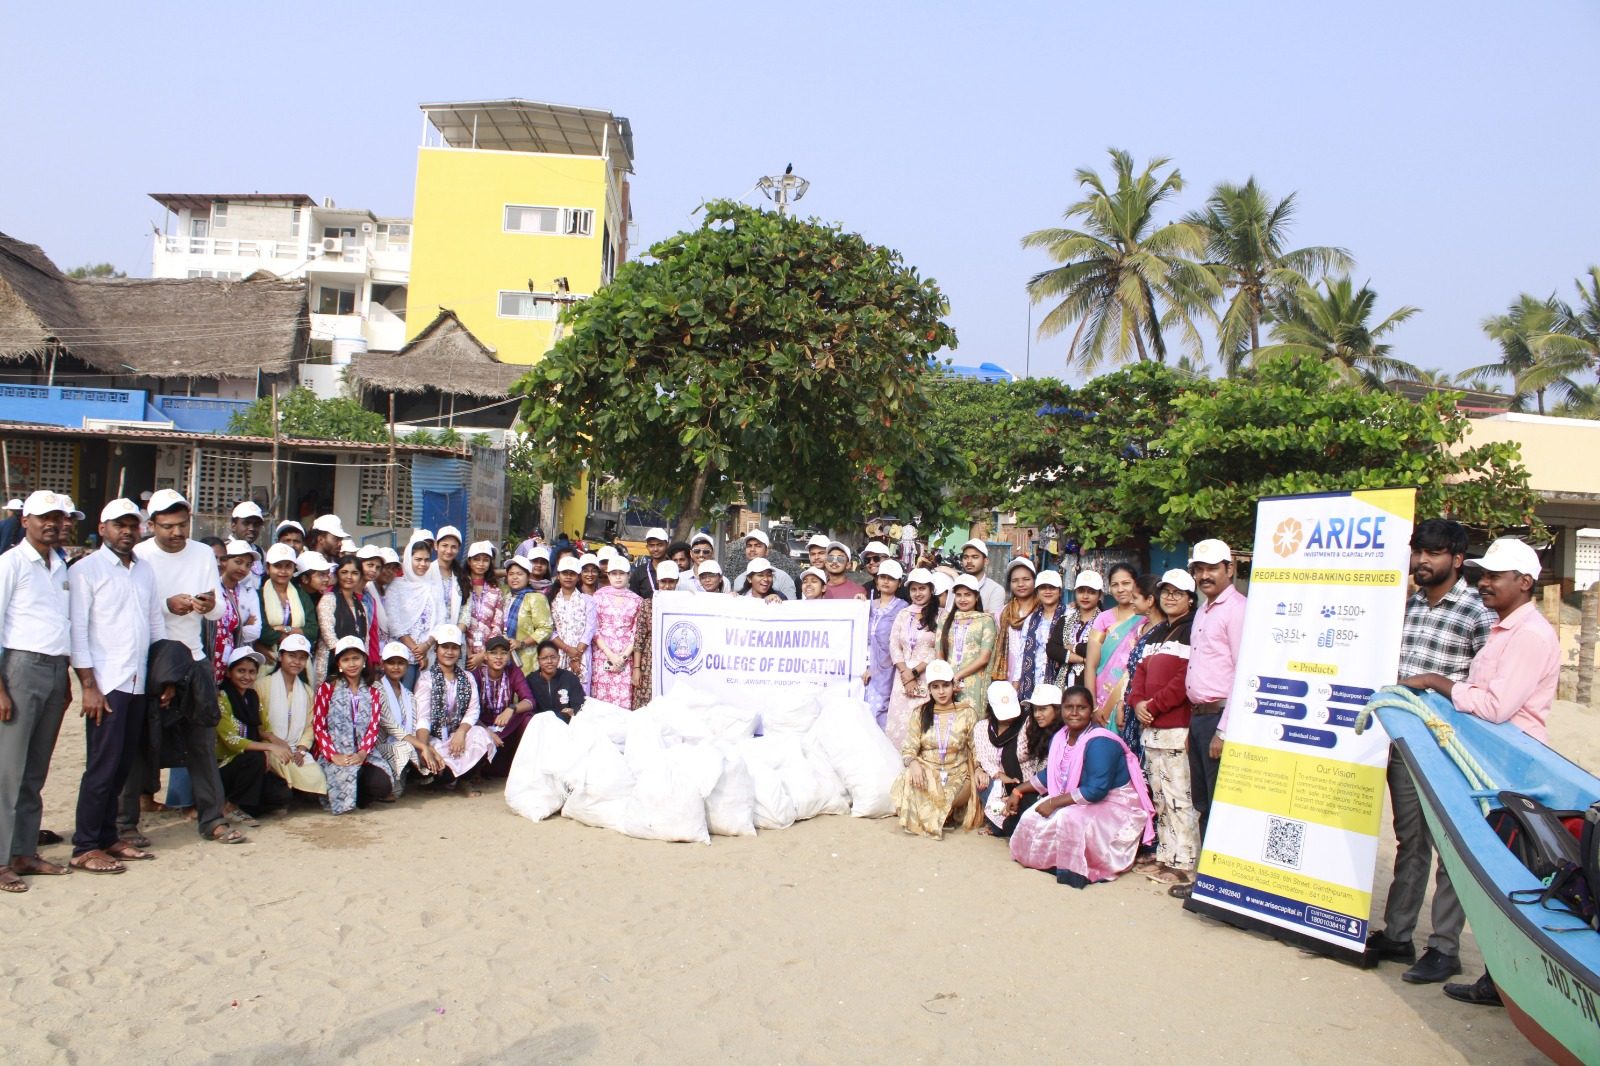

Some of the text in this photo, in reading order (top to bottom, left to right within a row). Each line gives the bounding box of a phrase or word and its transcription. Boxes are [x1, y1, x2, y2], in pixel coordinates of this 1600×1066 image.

[1305, 516, 1386, 550] ARISE
[1254, 571, 1396, 583] PEOPLE'S NON-BANKING SERVICES
[1288, 602, 1303, 613] 150
[1337, 605, 1365, 617] 1500+
[725, 628, 830, 650] VIVEKANANDHA
[1335, 629, 1359, 641] 850+
[705, 653, 756, 673] COLLEGE
[759, 656, 775, 673] OF
[777, 657, 846, 676] EDUCATION
[1300, 662, 1334, 675] Products
[1332, 690, 1362, 700] Multipurpose
[1308, 734, 1321, 742] Loan
[1228, 748, 1241, 759] Our
[1316, 764, 1356, 779] Our Vision
[1202, 882, 1216, 893] 0422
[1250, 896, 1303, 918] www.arisecapital.in
[1310, 909, 1347, 925] CUSTOMER CARE
